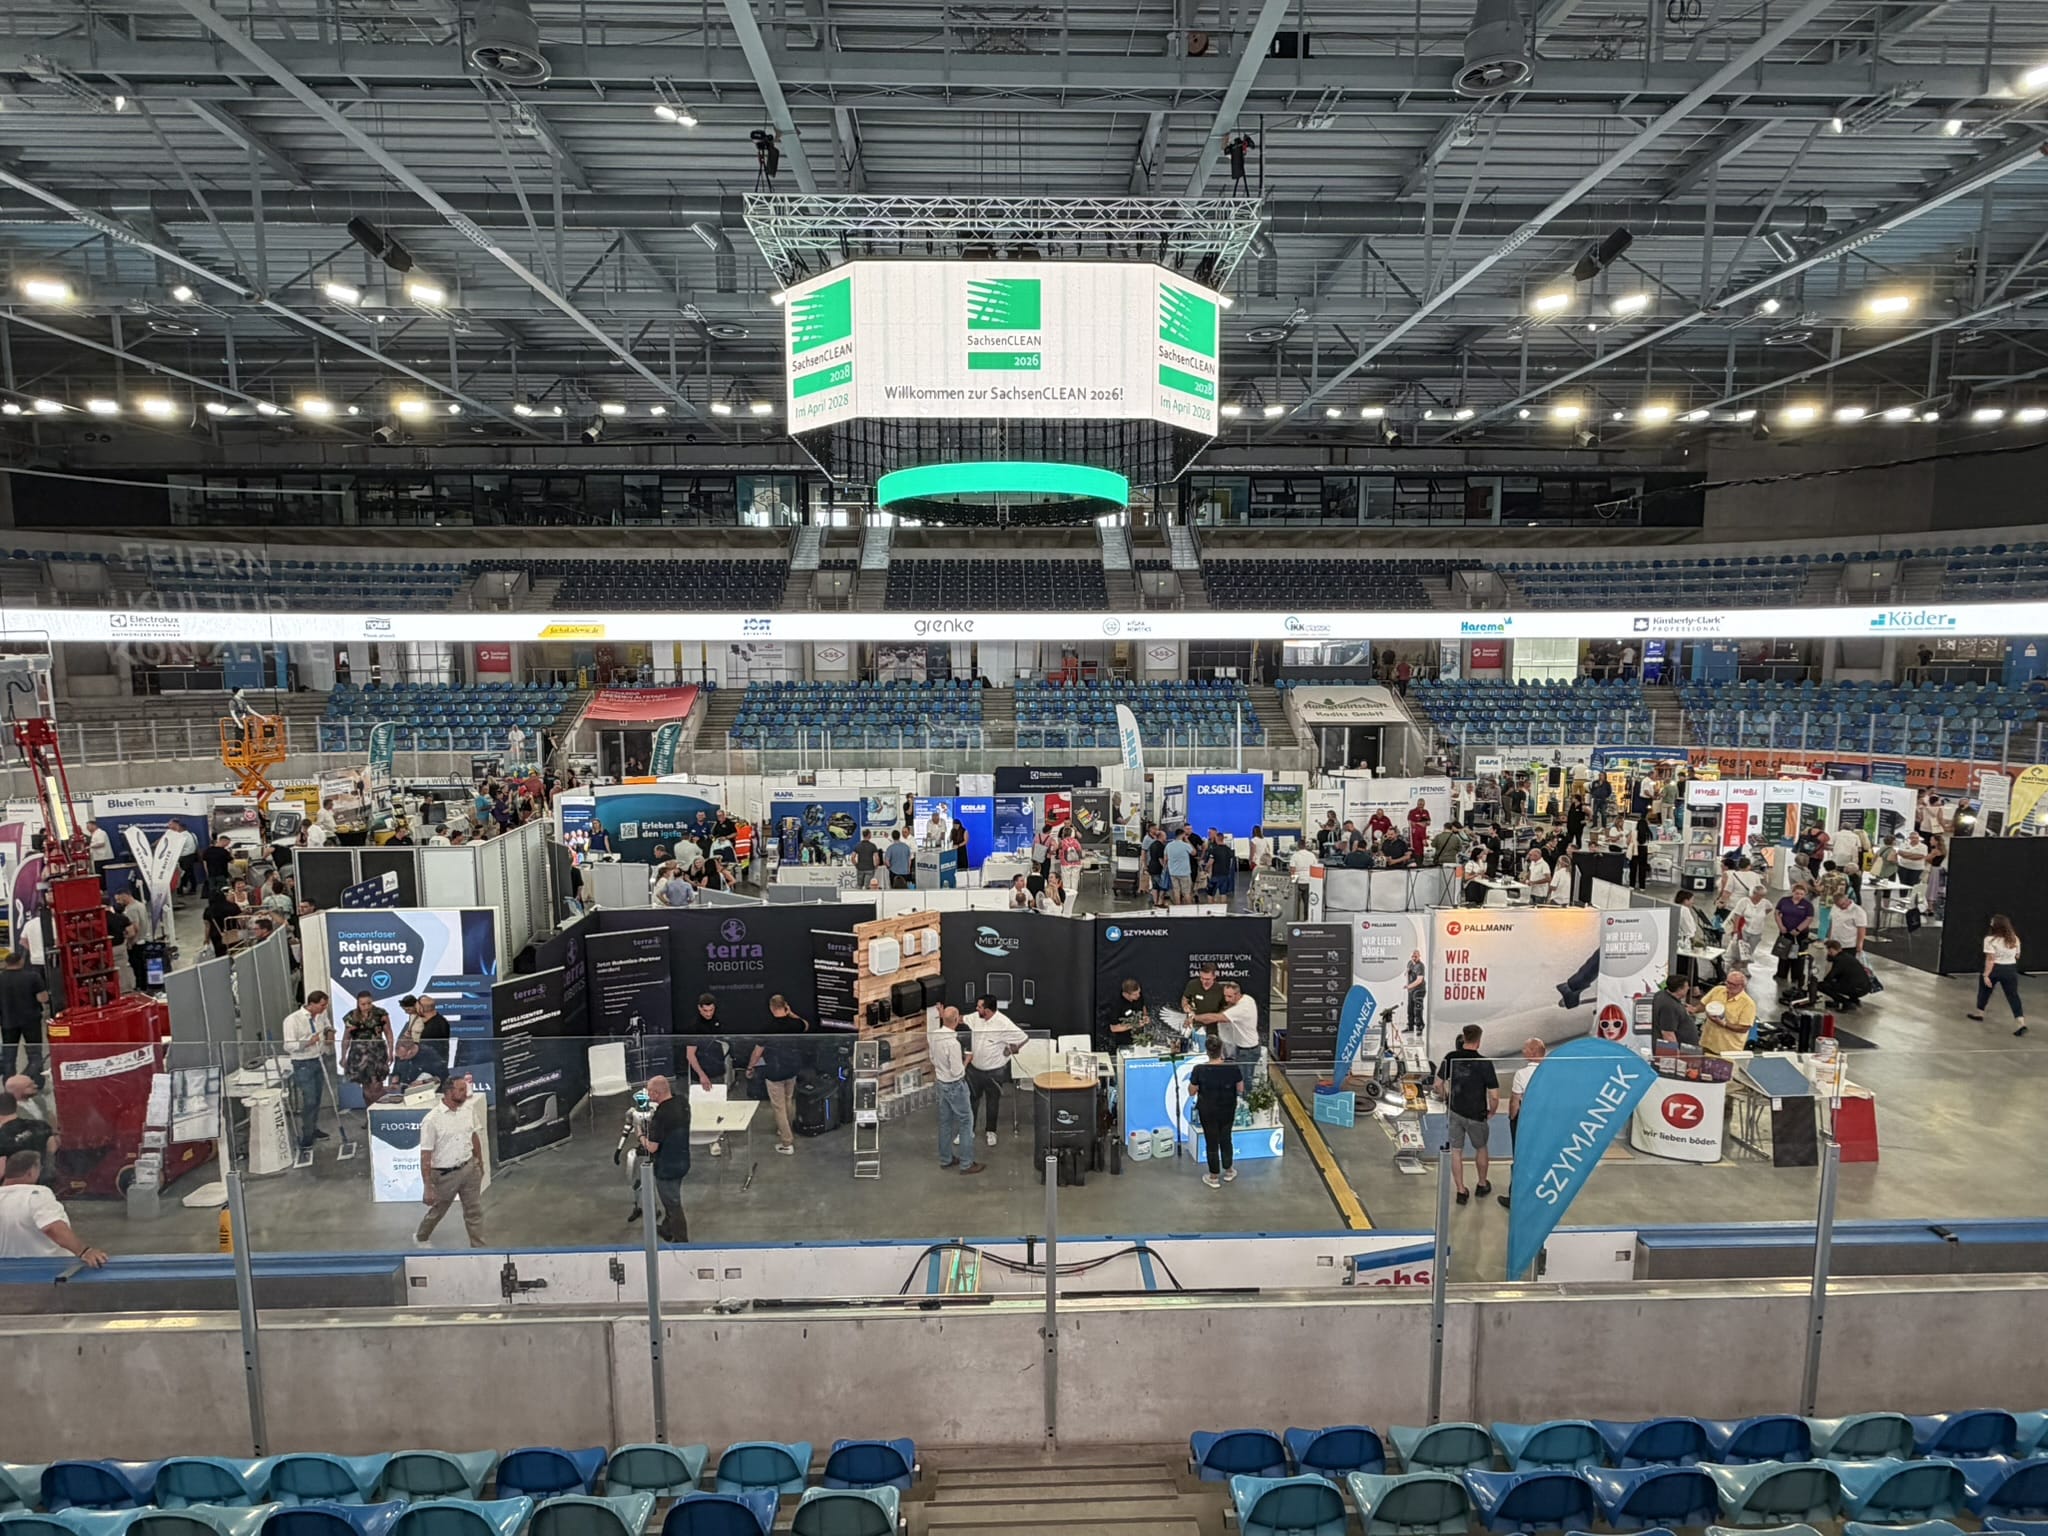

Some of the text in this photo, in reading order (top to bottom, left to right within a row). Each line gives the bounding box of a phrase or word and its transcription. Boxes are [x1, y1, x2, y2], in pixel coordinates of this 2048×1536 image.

[967, 335, 1041, 348] SachsenCLEAN
[792, 342, 853, 373] SachsenCLEAN
[1014, 354, 1039, 367] 2026
[1158, 345, 1215, 376] SachsenCLEAN
[829, 363, 851, 382] 2028
[884, 385, 1123, 401] Willkommen zur SachsenCLEAN 2026!
[1193, 379, 1214, 396] 2028
[794, 393, 849, 419] Im April 2028
[1160, 395, 1212, 421] Im April 2028
[129, 615, 179, 624] Electrolux
[1653, 616, 1721, 626] Kimberly-Clark
[1889, 610, 1947, 626] Köder
[914, 619, 975, 636] grenke
[1197, 784, 1254, 794] DR.SCHNELL
[107, 798, 156, 809] BlueTem
[642, 822, 688, 830] Erleben Sie
[642, 830, 659, 838] den
[338, 931, 396, 939] Diamantfaser
[1123, 928, 1169, 937] SZYMANEK
[1464, 924, 1512, 933] PALLMANN
[978, 936, 1019, 945] METZGER
[1361, 935, 1402, 946] WIR LIEBEN
[1606, 931, 1618, 941] WIR
[339, 940, 407, 954] Reinigung
[706, 942, 763, 959] terra
[1361, 945, 1385, 957] BÖDEN
[340, 954, 414, 965] auf smarte
[1189, 954, 1234, 962] BEGEISTERT
[1446, 950, 1469, 965] WIR
[341, 967, 368, 978] Art.
[707, 960, 764, 972] ROBOTICS
[1445, 968, 1487, 982] LIEBEN
[514, 987, 537, 1000] terra
[1444, 983, 1485, 1001] BÖDEN
[1341, 997, 1374, 1064] SZYMANEK
[1668, 1101, 1698, 1121] rz
[1535, 1064, 1640, 1206] SZYMANEK
[1643, 1130, 1718, 1146] wir lieben böden.
